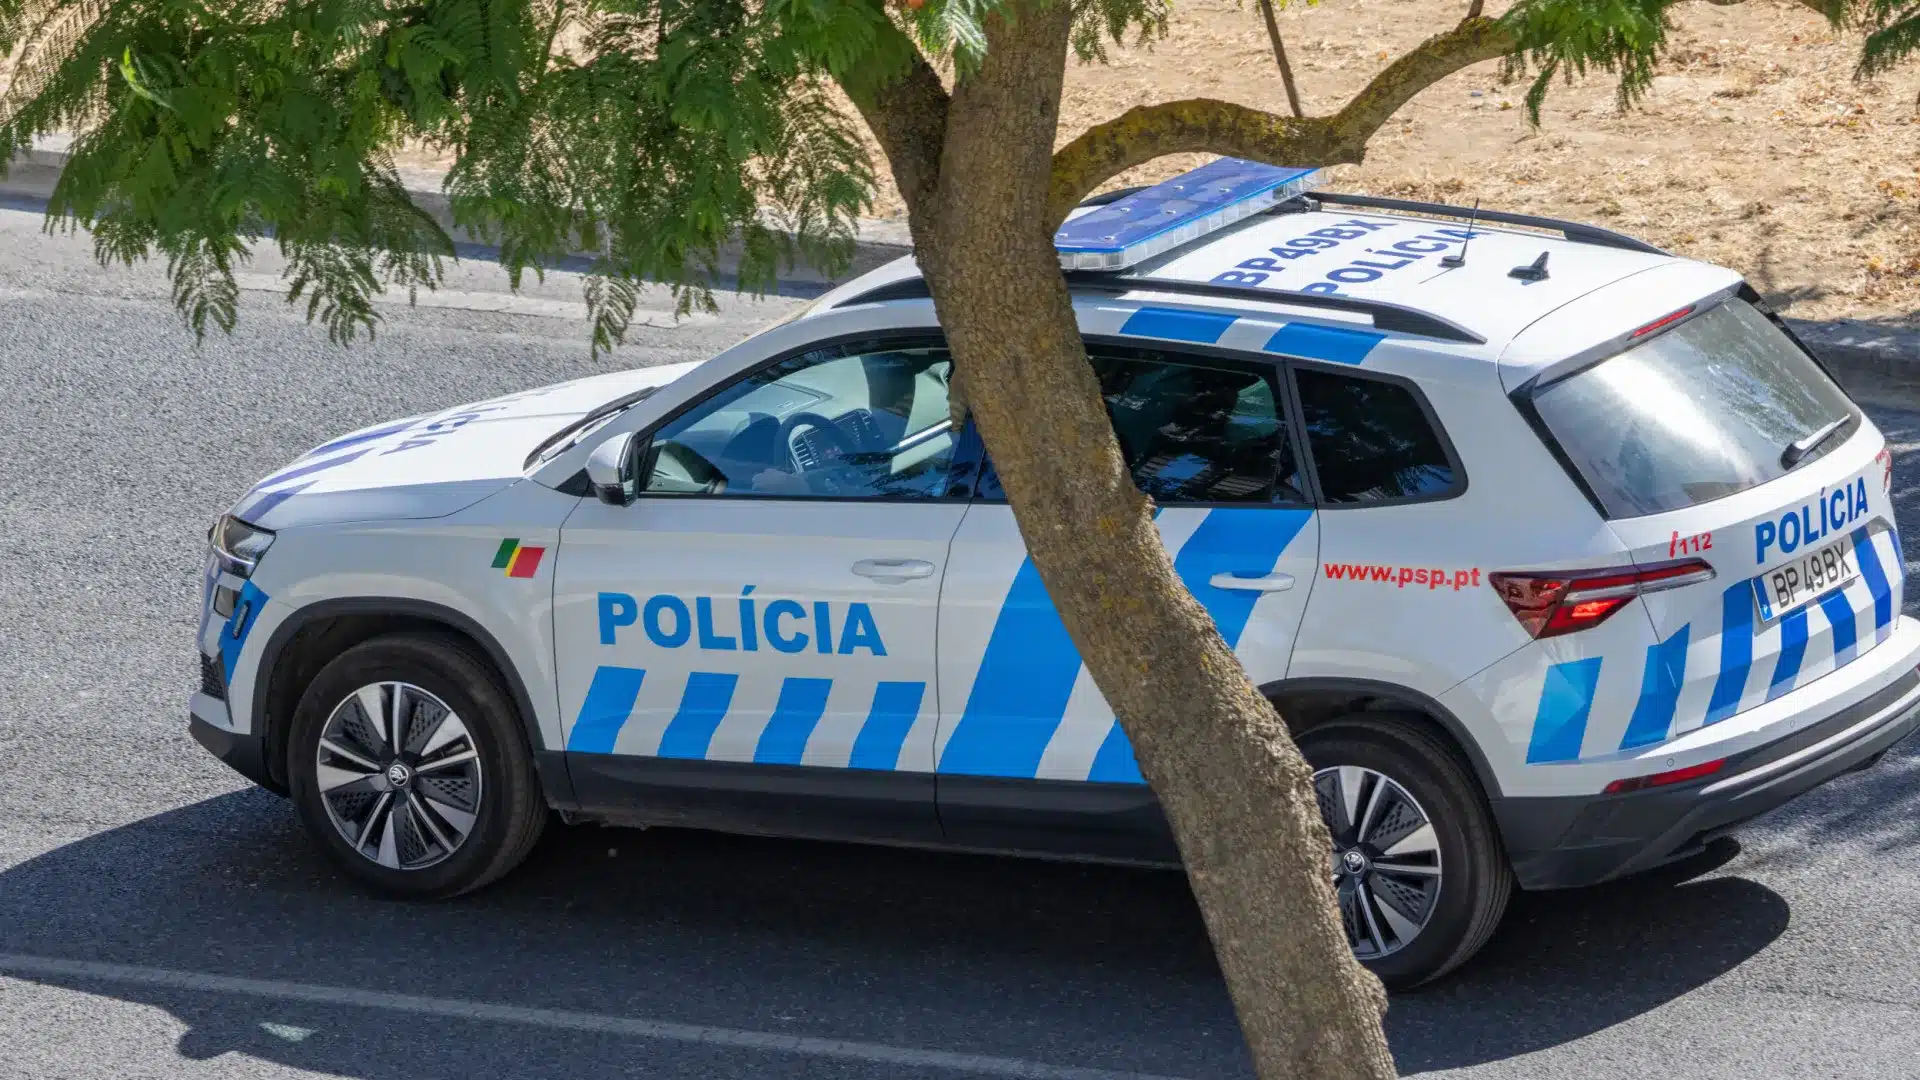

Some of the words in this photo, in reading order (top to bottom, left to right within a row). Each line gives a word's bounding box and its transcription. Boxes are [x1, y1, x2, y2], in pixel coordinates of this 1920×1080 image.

[1208, 218, 1400, 288] BP49BX
[1300, 229, 1495, 297] POLÍCIA
[1755, 476, 1869, 565] POLÍCIA
[1324, 561, 1481, 591] www.psp.pt
[597, 584, 888, 657] POLÍCIA
